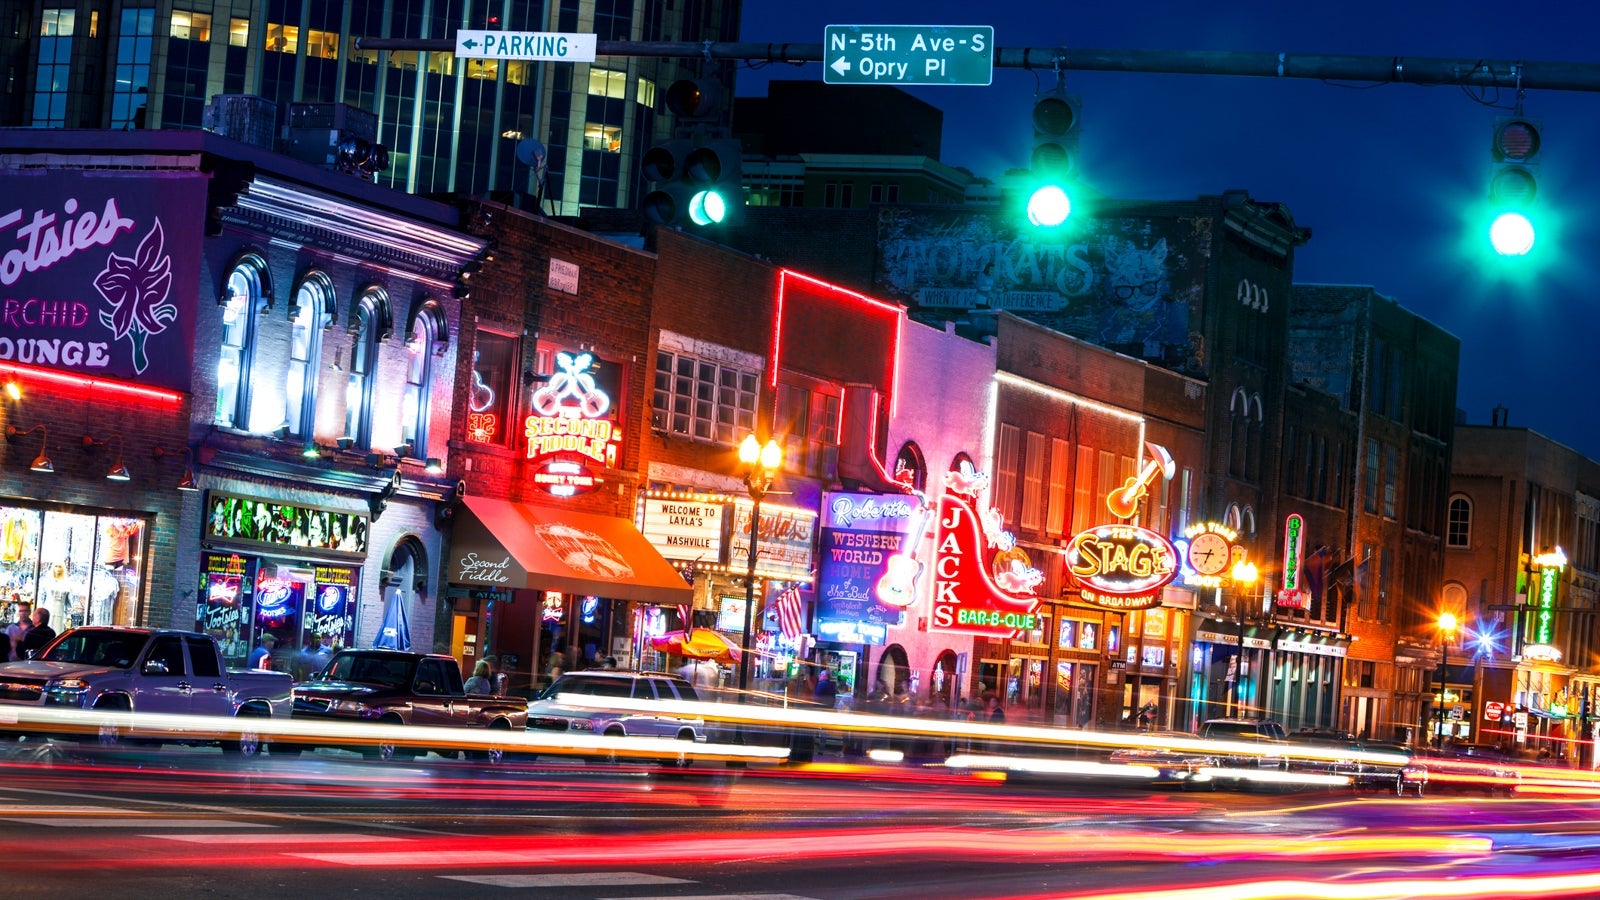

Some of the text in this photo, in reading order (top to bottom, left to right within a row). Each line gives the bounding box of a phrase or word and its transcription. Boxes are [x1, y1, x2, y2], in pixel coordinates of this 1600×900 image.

[484, 34, 568, 57] PARKING
[831, 33, 985, 53] N-5th Ave-S
[859, 57, 946, 80] Opry Pl
[1003, 293, 1053, 309] DIFFERENCE
[525, 416, 611, 442] SECOND
[527, 435, 606, 463] FIDDLE
[661, 504, 715, 517] WELCOME TO
[669, 517, 703, 527] LAYLA'S
[666, 536, 710, 548] NASHVILLE
[832, 532, 902, 550] WESTERN
[460, 552, 510, 570] Second
[831, 549, 883, 565] WORLD
[1071, 532, 1172, 578] STAGE
[459, 566, 509, 583] Fiddle
[830, 564, 871, 579] HOME
[934, 507, 963, 627] JACKS
[827, 583, 870, 600] Sho-Bud
[843, 578, 852, 590] of
[475, 591, 501, 602] ATM
[1081, 589, 1154, 607] ON BROADWAY
[205, 606, 239, 630] Tootsies
[958, 609, 1035, 630] BAR-B-QUE
